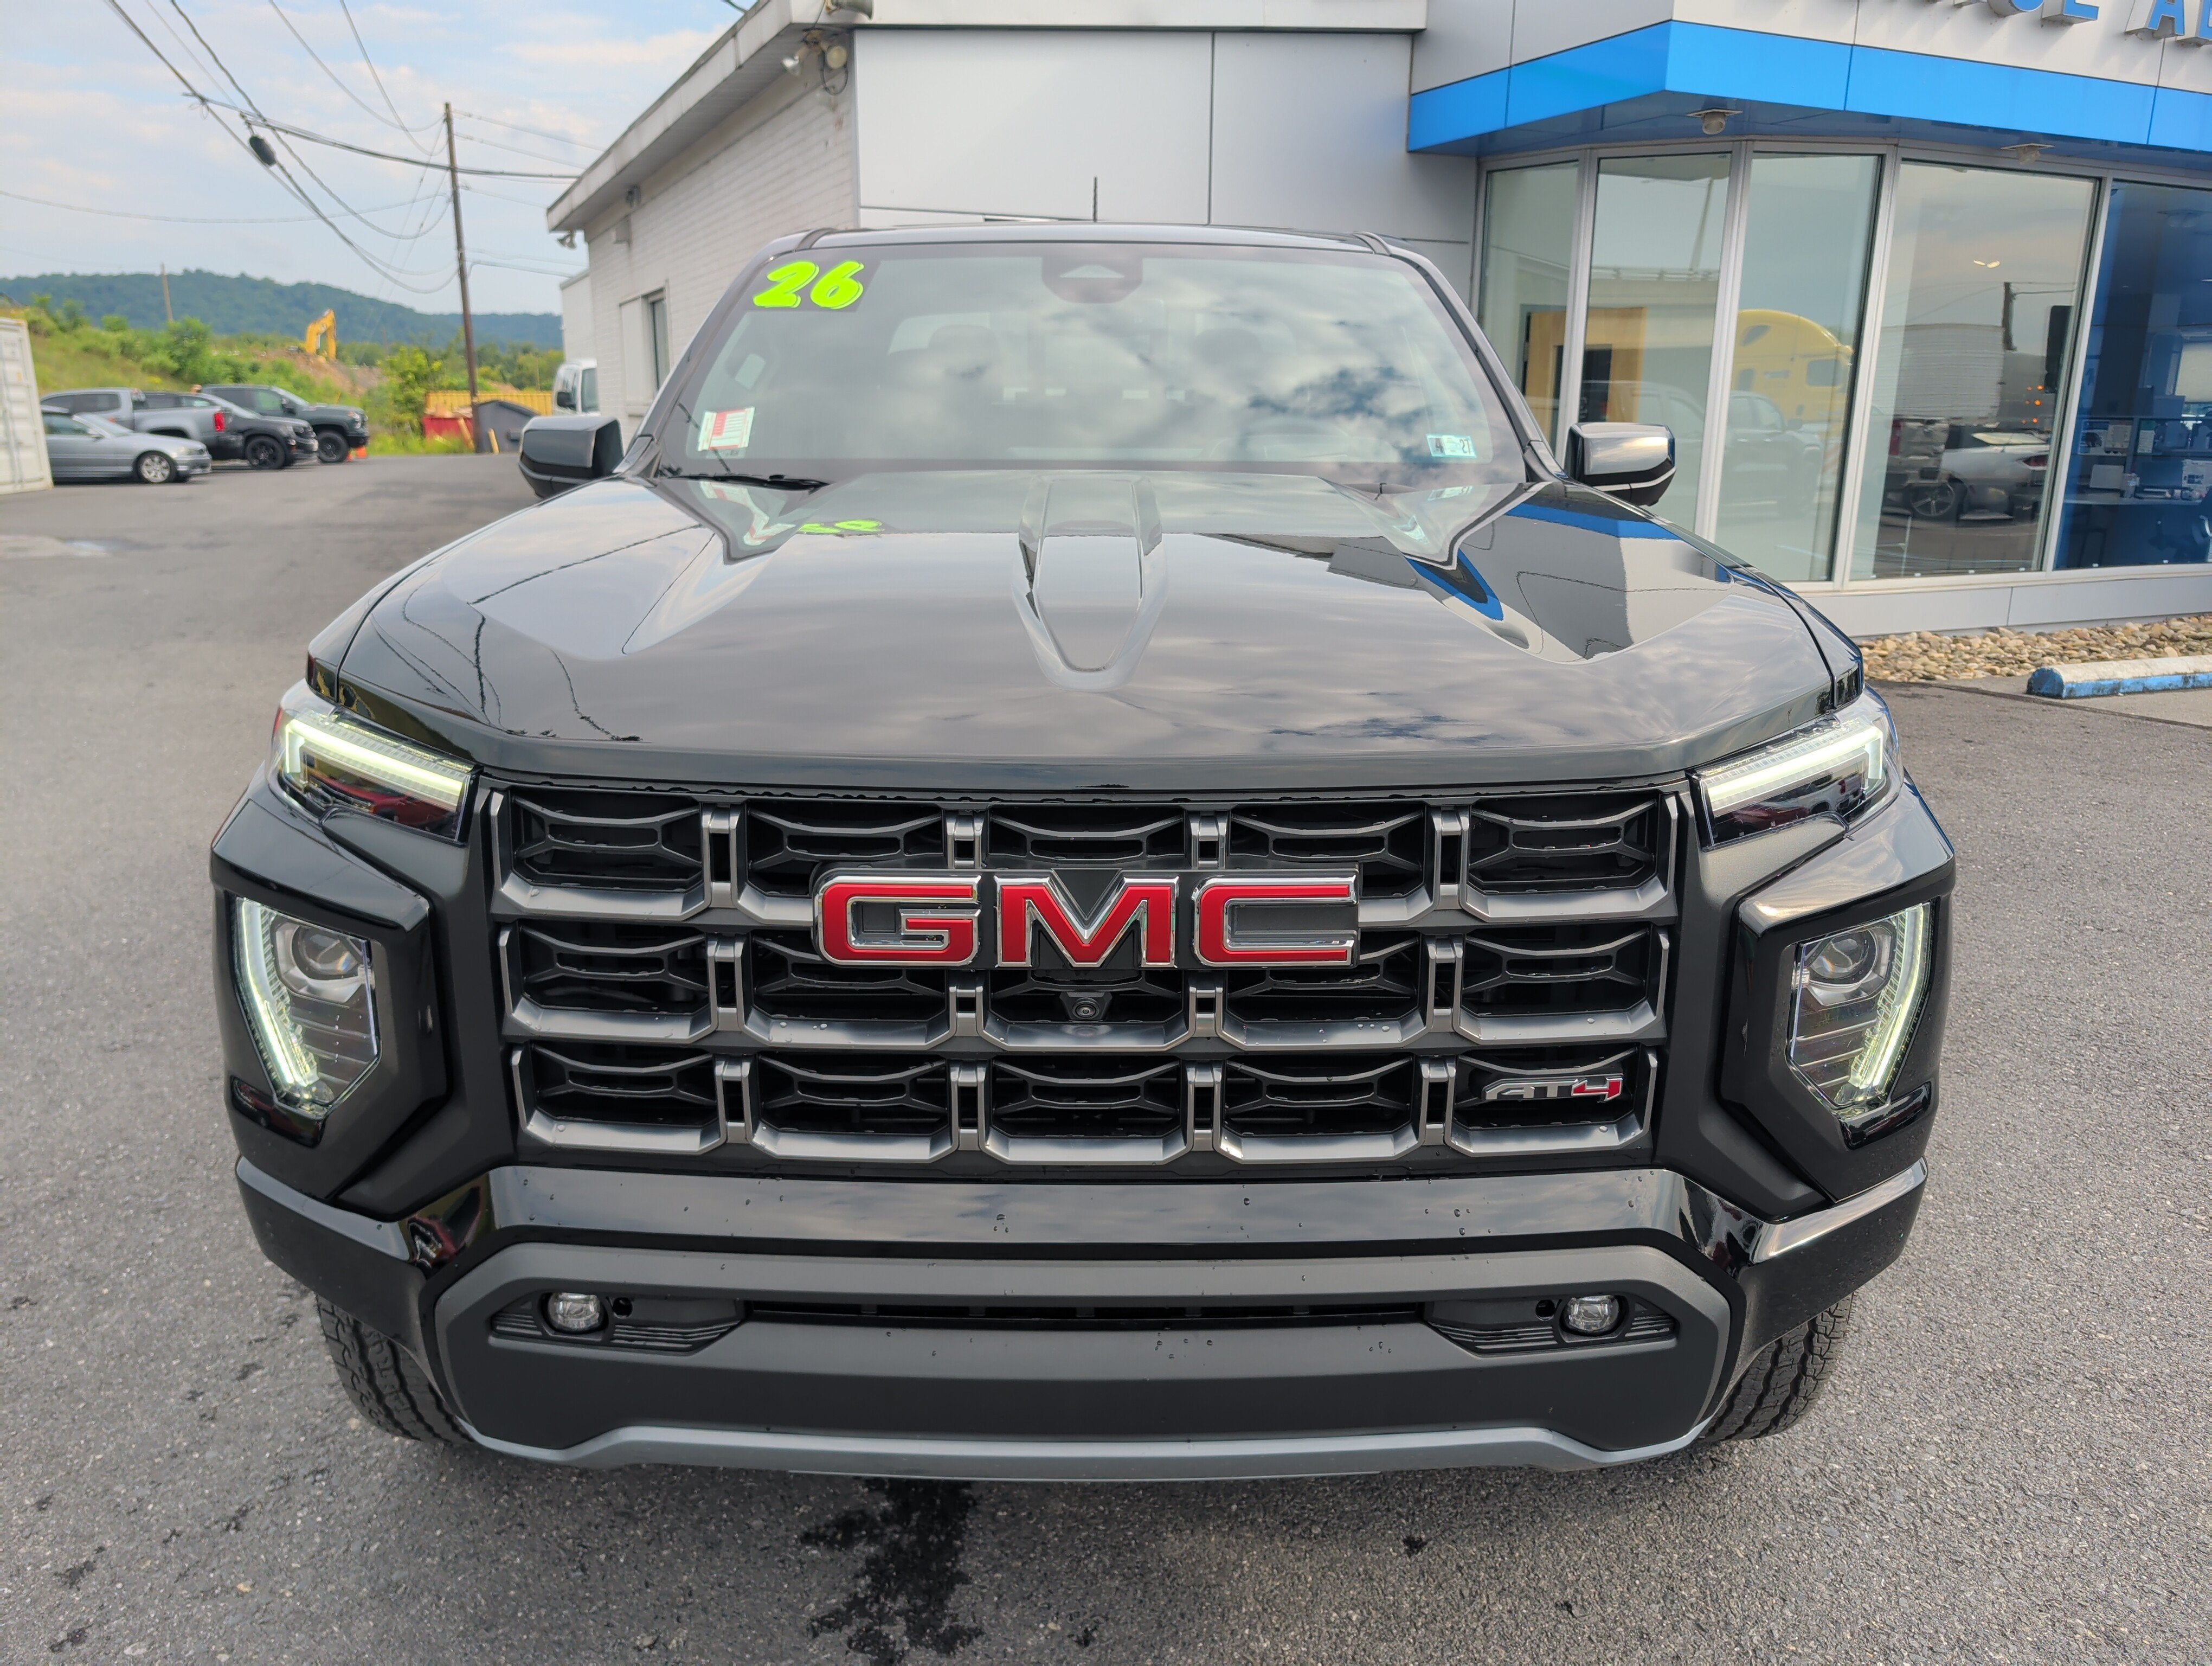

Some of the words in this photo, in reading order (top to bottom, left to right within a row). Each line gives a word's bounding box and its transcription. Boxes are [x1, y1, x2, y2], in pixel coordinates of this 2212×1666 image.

[753, 260, 864, 309] 26
[814, 874, 1359, 968] GMC
[1483, 1075, 1623, 1102] AT4
